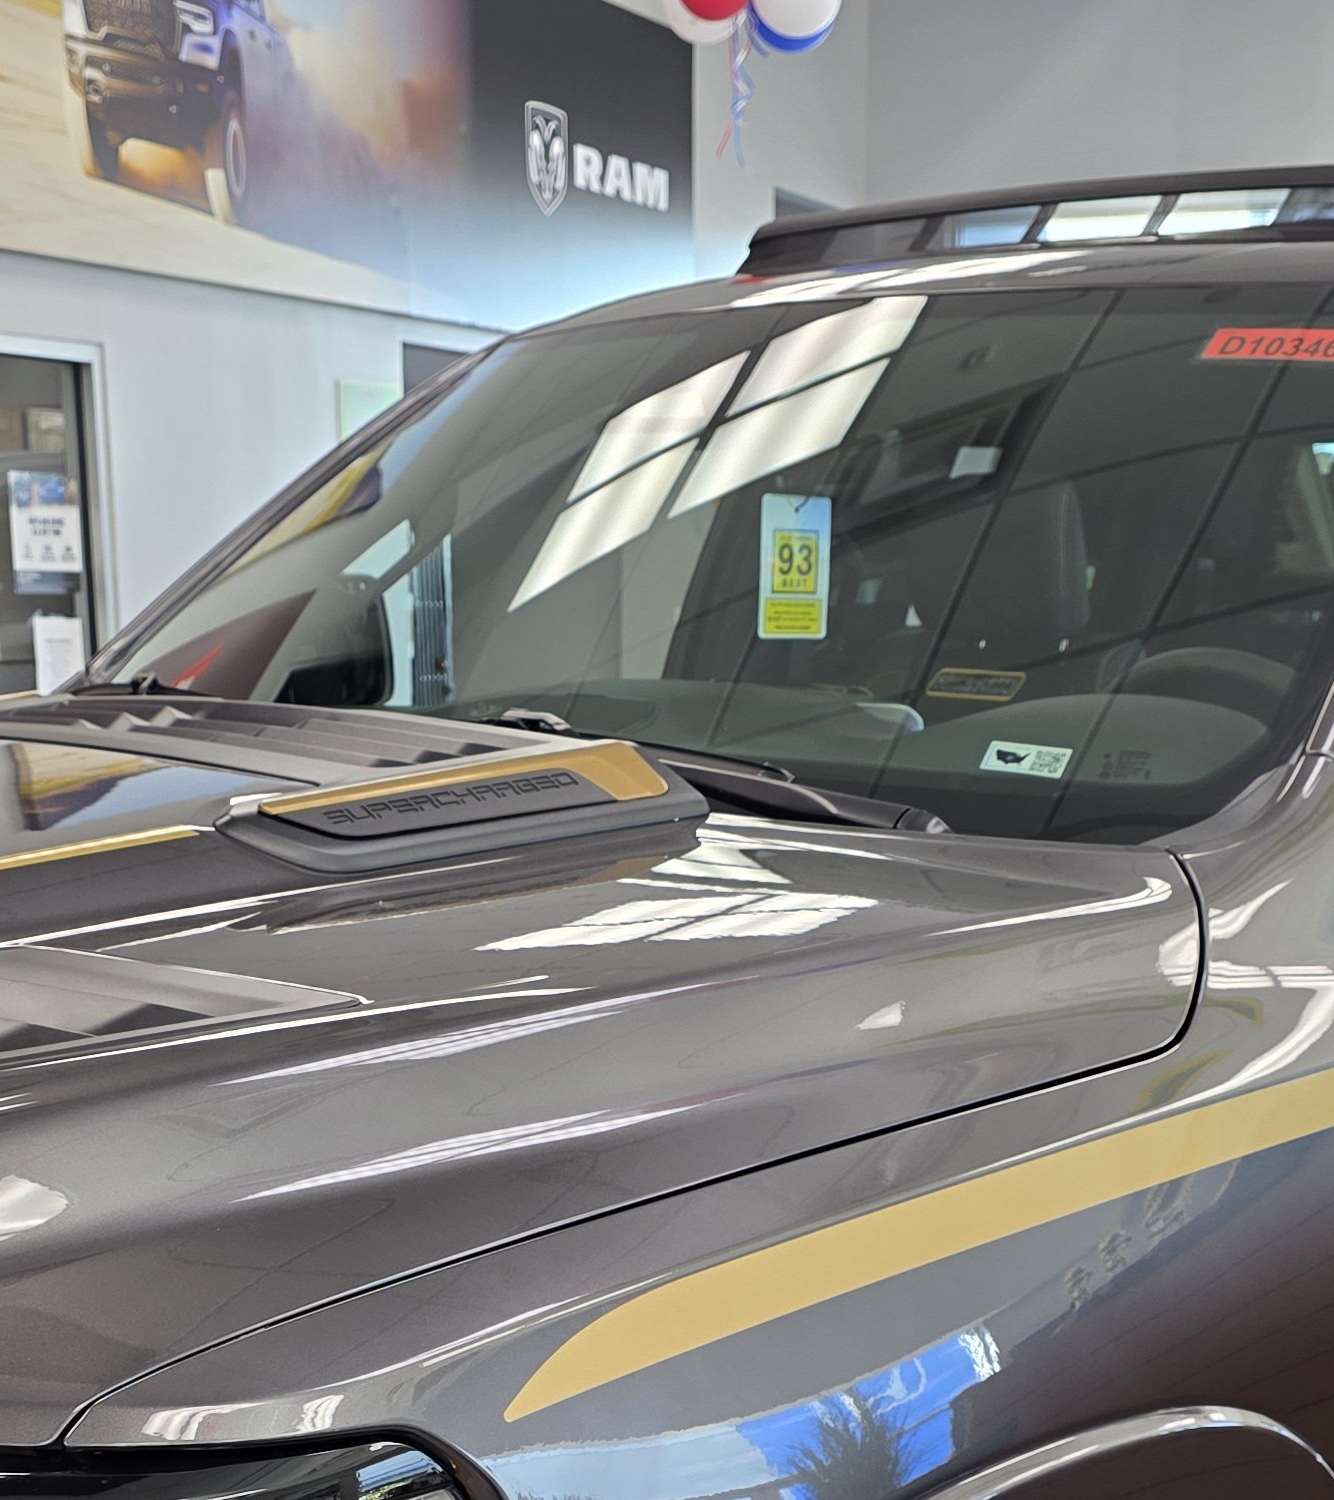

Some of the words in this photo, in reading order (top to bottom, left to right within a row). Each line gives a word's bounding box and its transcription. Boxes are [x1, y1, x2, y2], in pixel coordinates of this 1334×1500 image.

[573, 143, 669, 213] RAM
[778, 542, 813, 577] 93
[322, 771, 580, 825] SUPERCHARGED
